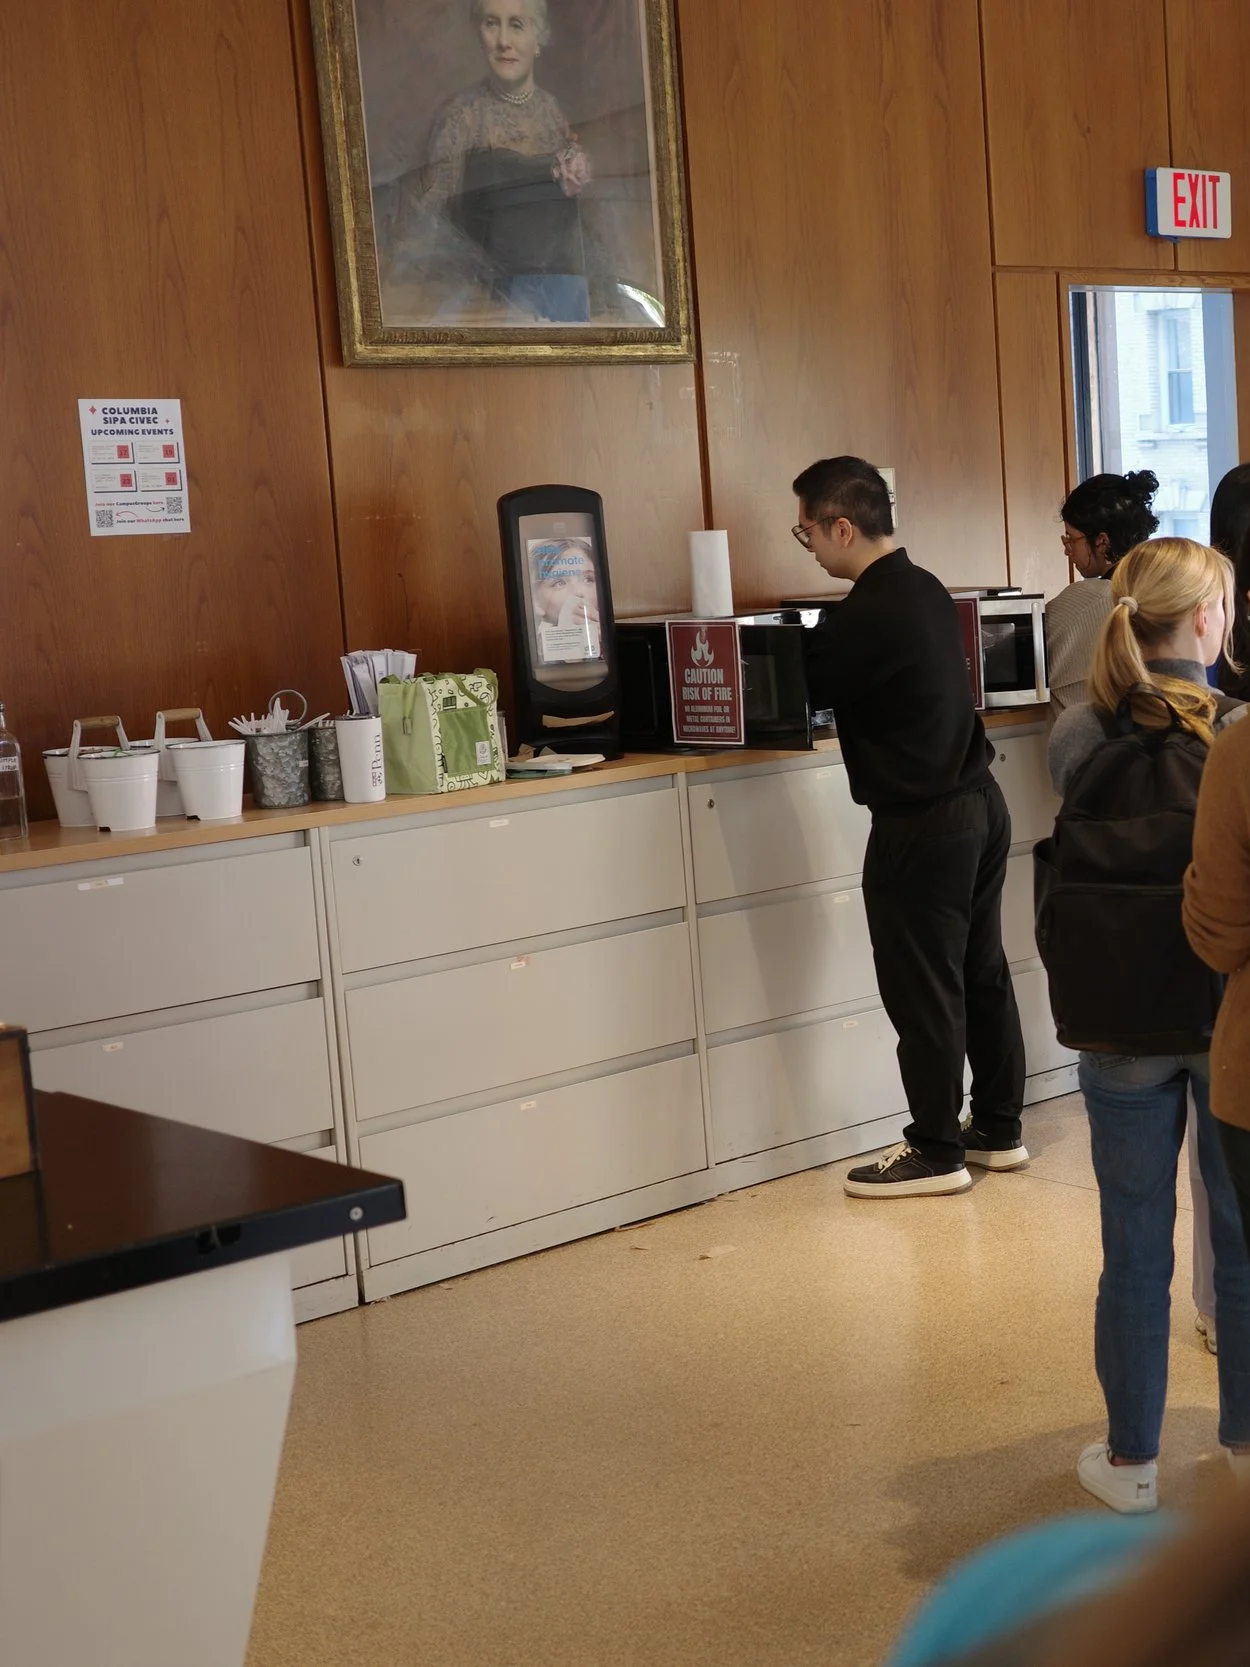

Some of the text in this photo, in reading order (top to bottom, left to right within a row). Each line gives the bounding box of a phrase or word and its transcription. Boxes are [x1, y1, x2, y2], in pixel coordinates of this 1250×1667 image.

[1173, 172, 1220, 229] EXIT
[101, 407, 158, 415] COLUMBIA
[128, 416, 158, 424] CIVEC
[684, 668, 724, 684] CAUTION
[682, 687, 732, 700] RISK OF FIRE
[371, 734, 382, 770] Penn
